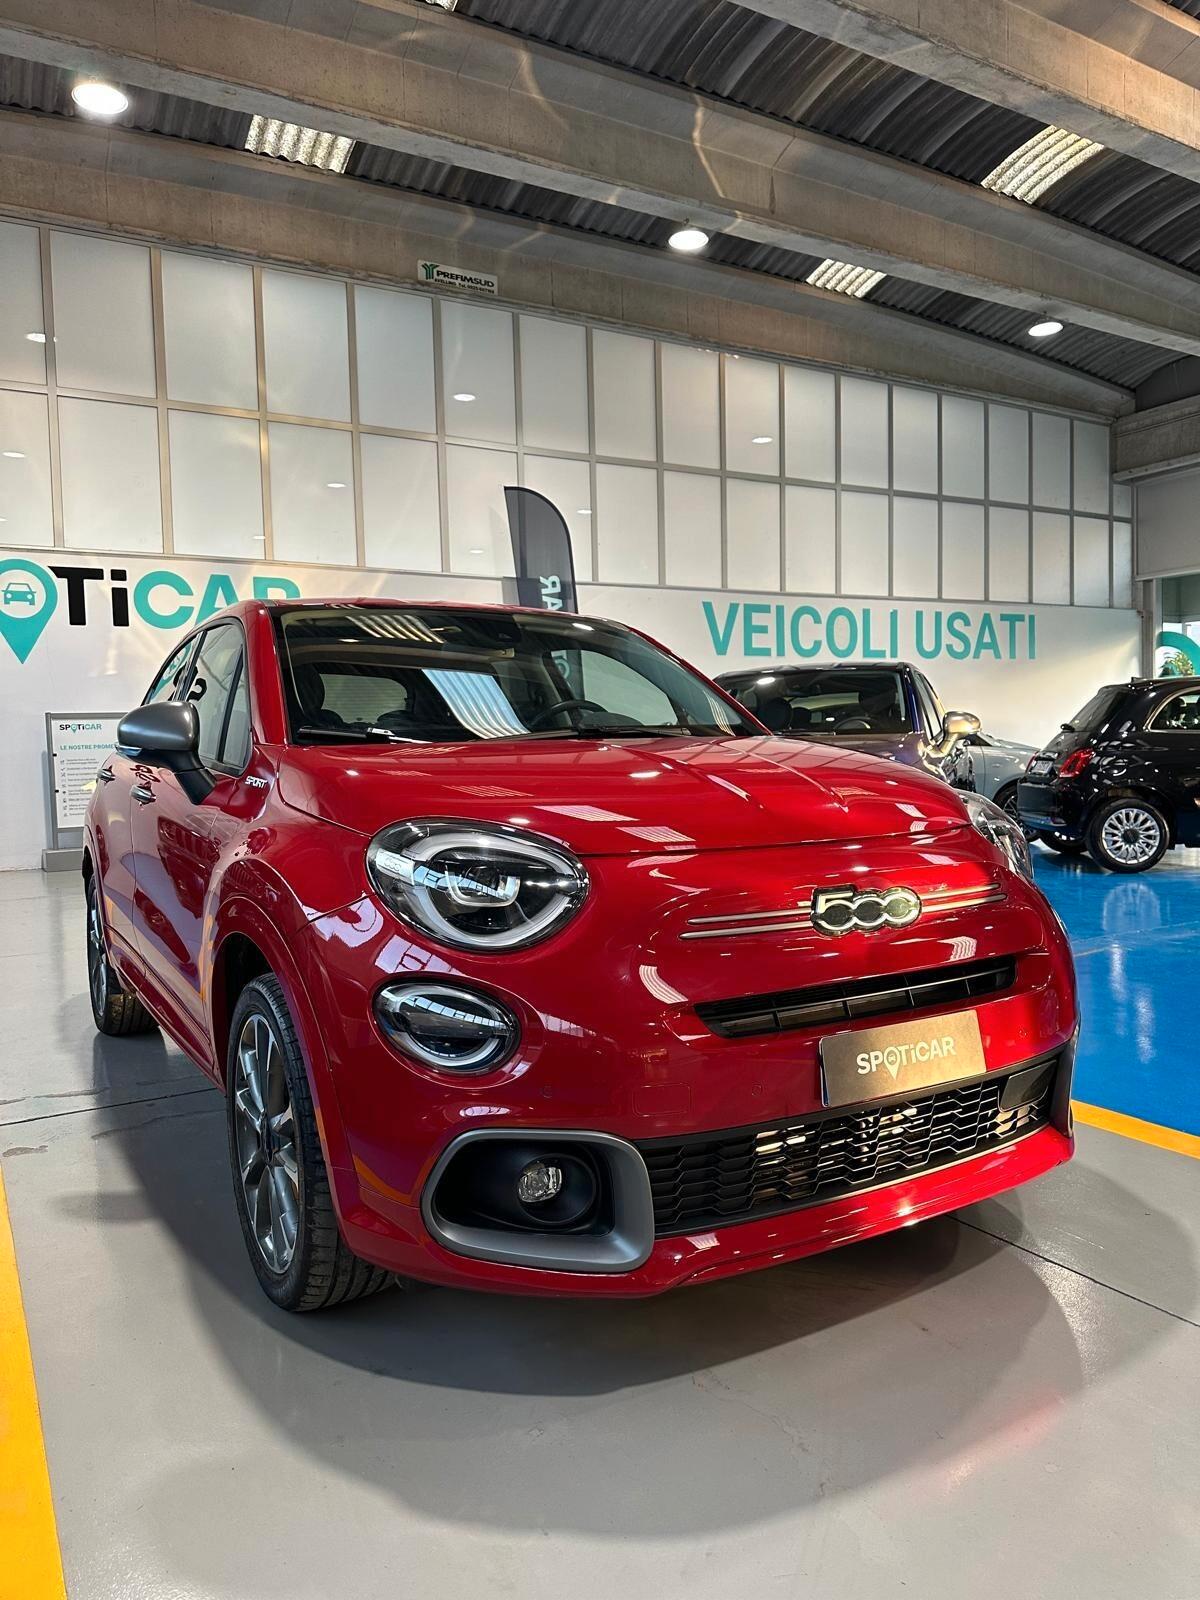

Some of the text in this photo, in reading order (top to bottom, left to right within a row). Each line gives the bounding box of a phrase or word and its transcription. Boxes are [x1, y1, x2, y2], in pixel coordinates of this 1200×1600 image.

[436, 270, 495, 288] PREFIMSUD
[702, 600, 1036, 660] VEICOLI USATI
[245, 775, 268, 789] SPORT
[811, 884, 922, 937] 500
